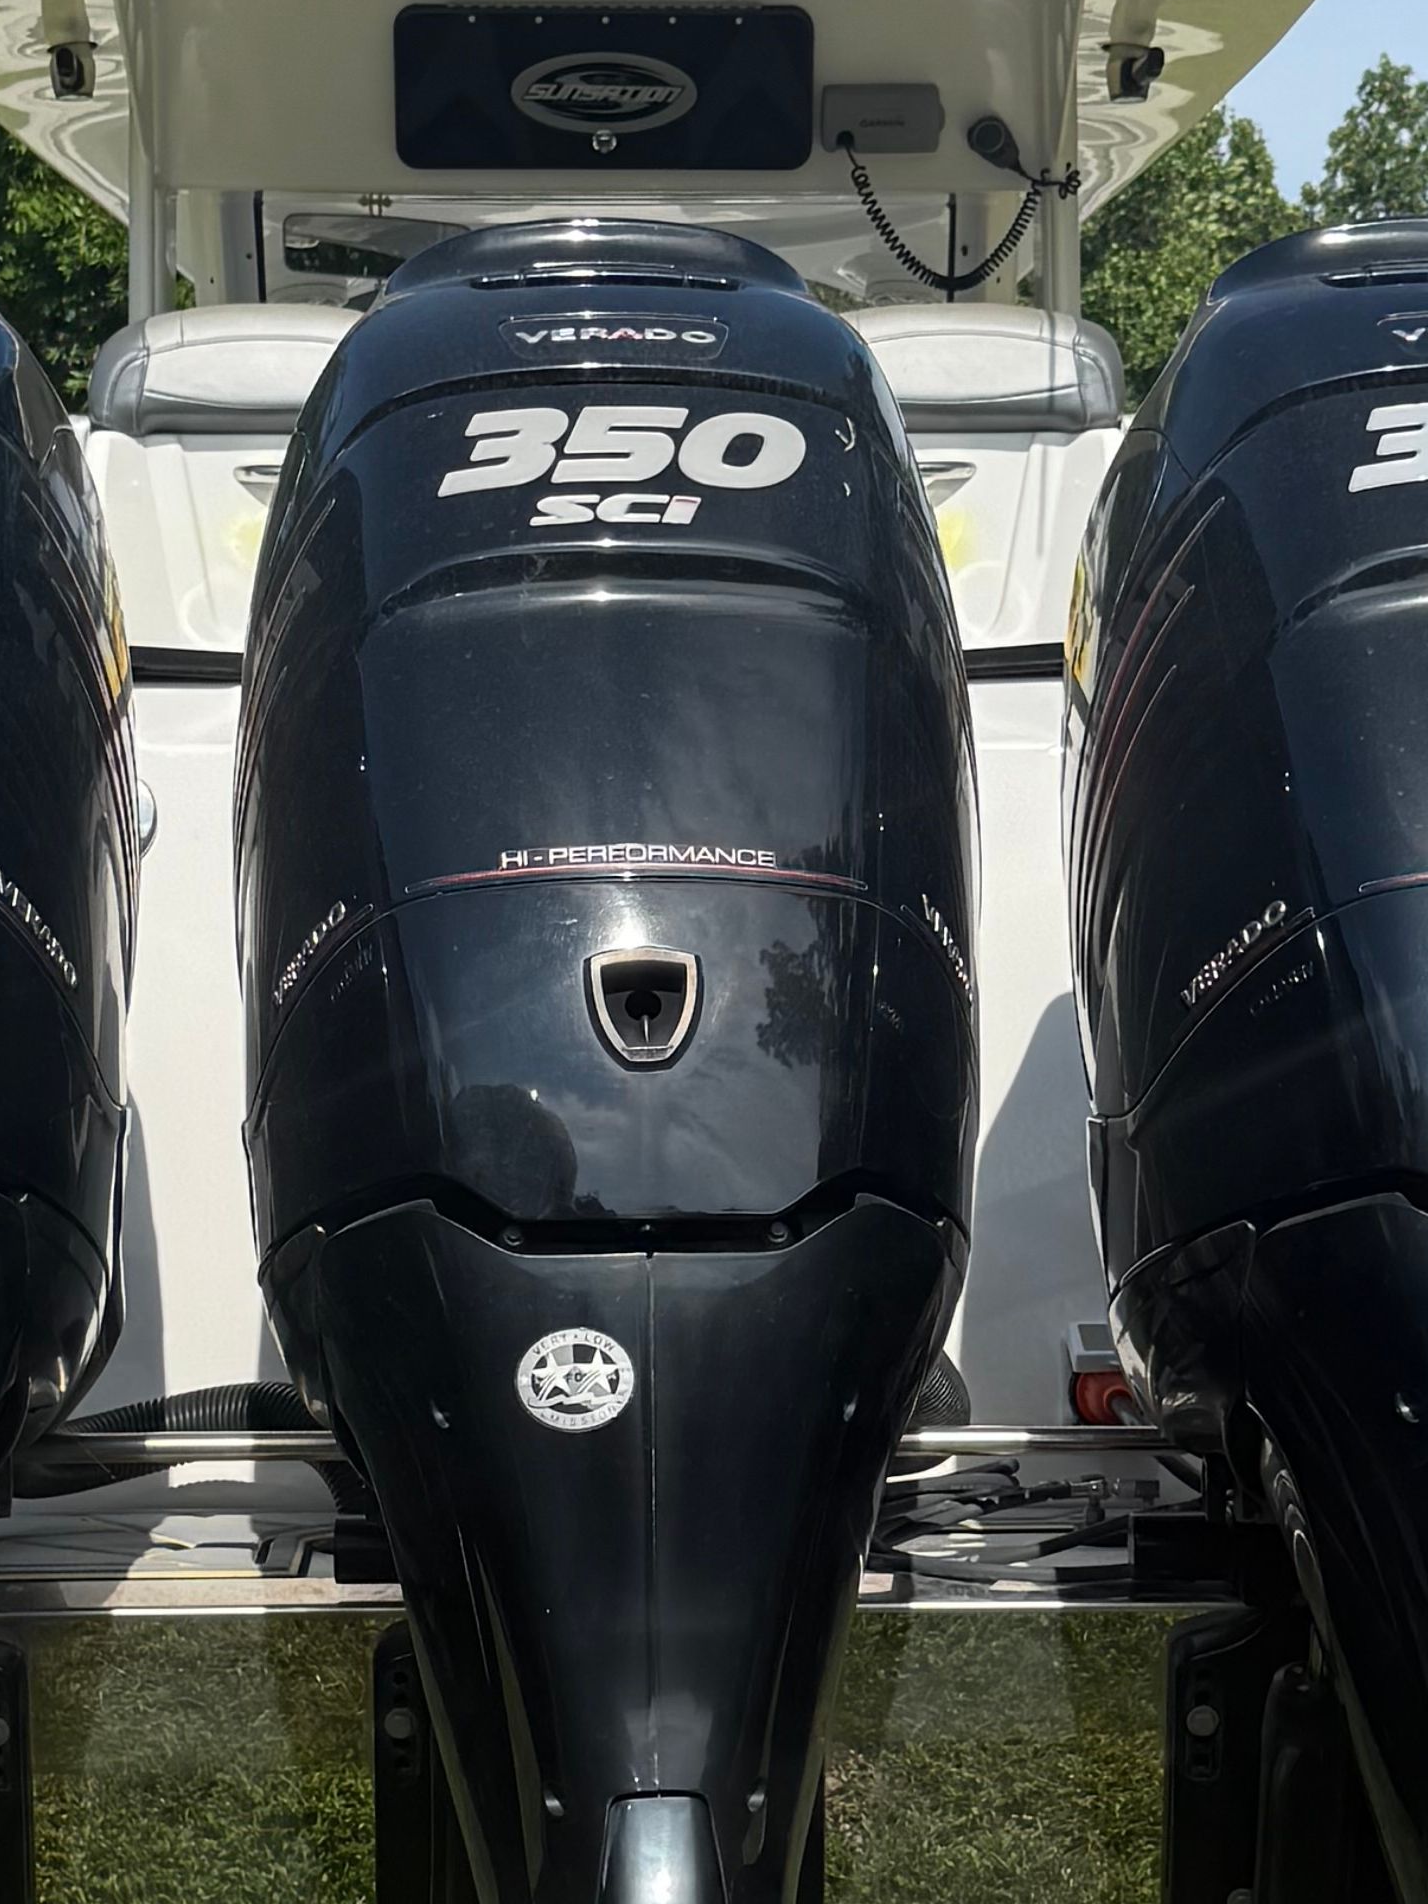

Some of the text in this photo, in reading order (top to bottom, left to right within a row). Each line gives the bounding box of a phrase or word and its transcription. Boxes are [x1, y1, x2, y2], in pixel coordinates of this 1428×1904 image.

[523, 83, 684, 103] SUNSATION
[516, 327, 717, 344] VERADO
[437, 406, 806, 497] 350
[532, 1333, 616, 1356] VERY LOW
